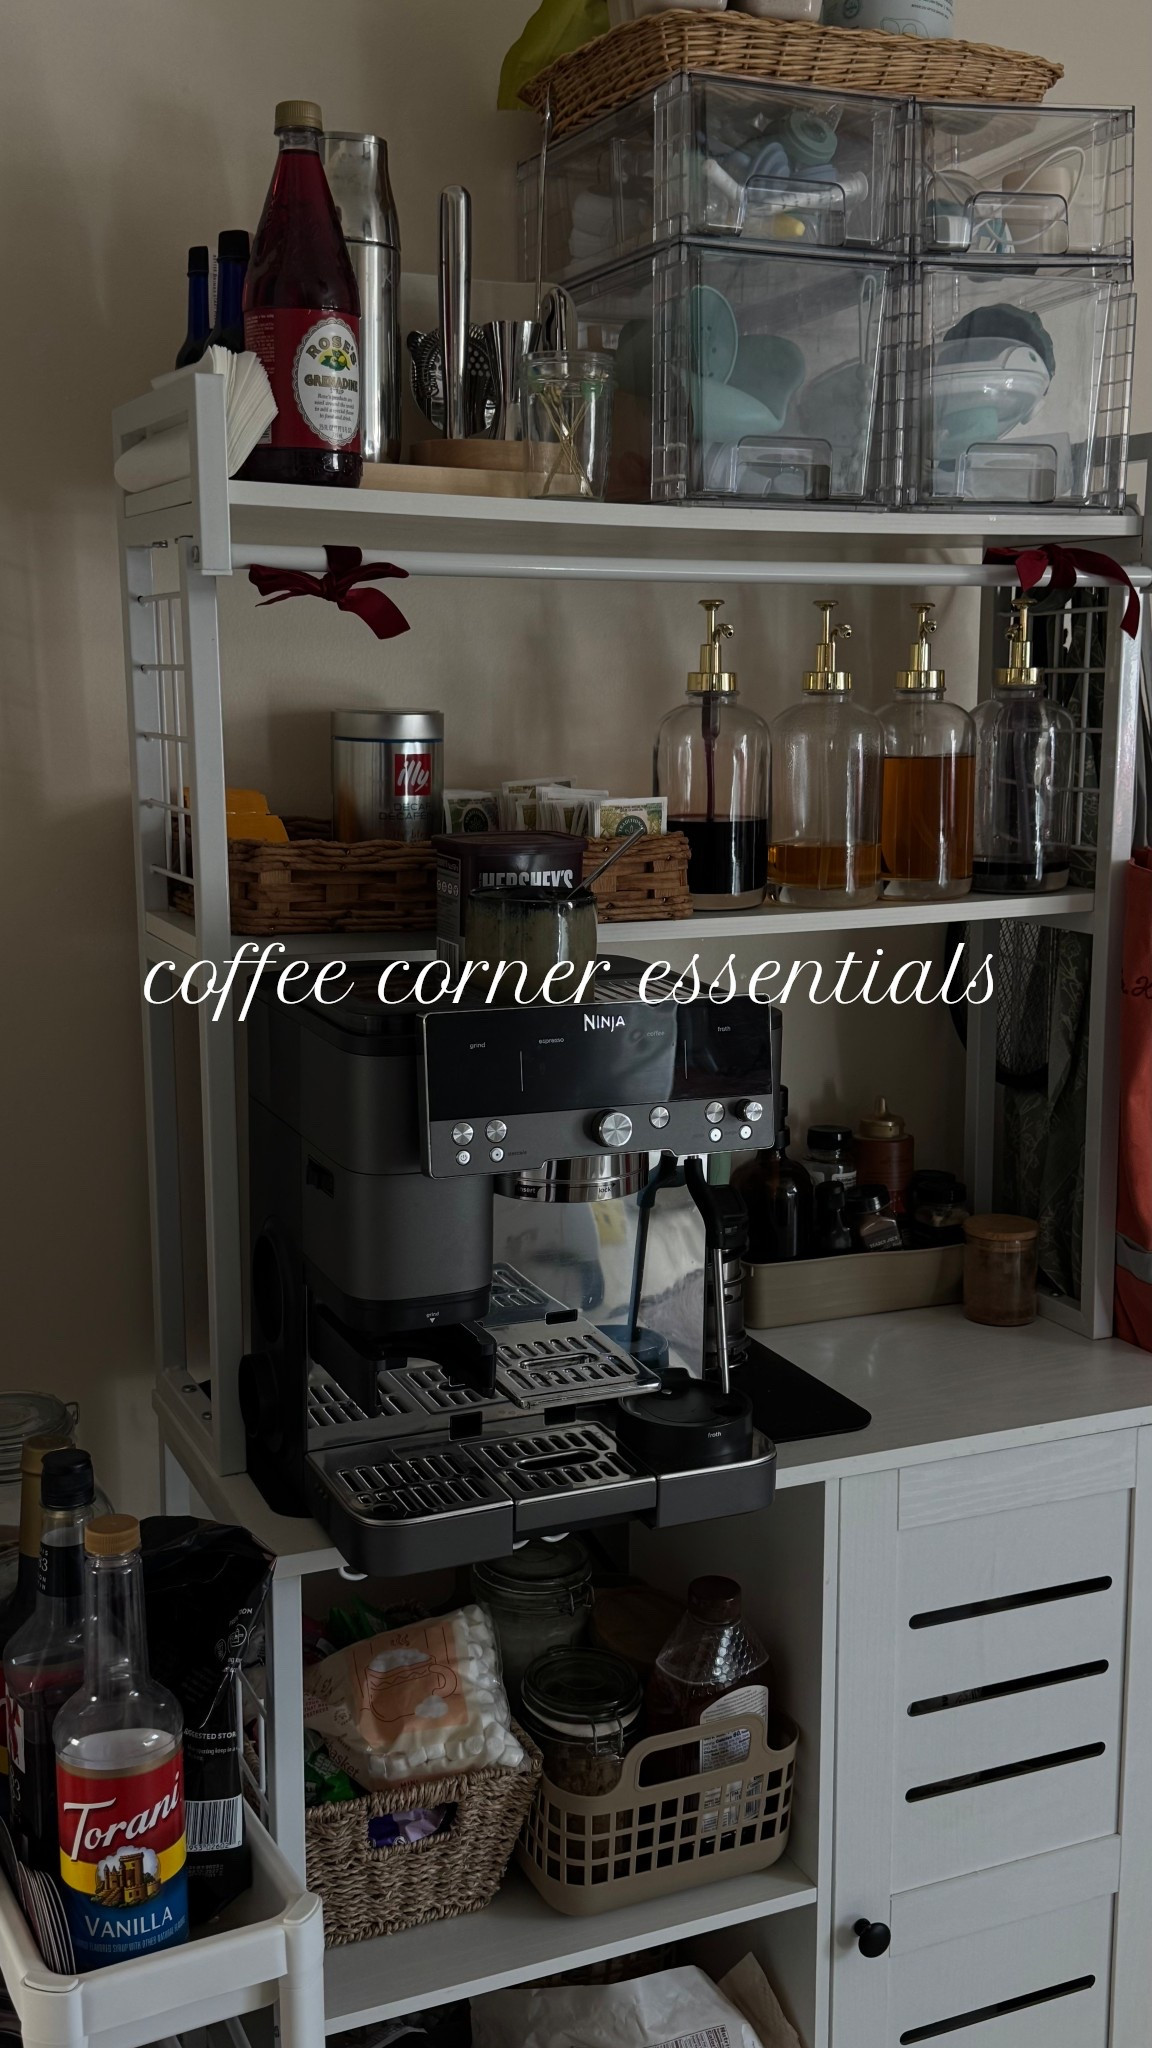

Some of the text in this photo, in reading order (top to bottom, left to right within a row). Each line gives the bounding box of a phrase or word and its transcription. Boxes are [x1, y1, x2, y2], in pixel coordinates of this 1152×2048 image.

[306, 335, 357, 366] ROSE'S
[304, 374, 358, 392] GRENADINE
[397, 760, 430, 792] illy
[583, 1013, 625, 1032] NINJA
[469, 1042, 486, 1050] grind
[538, 1037, 565, 1045] espresso
[218, 1731, 237, 1740] STOR
[63, 1770, 180, 1862] Torani
[84, 1905, 173, 1939] VANILLA
